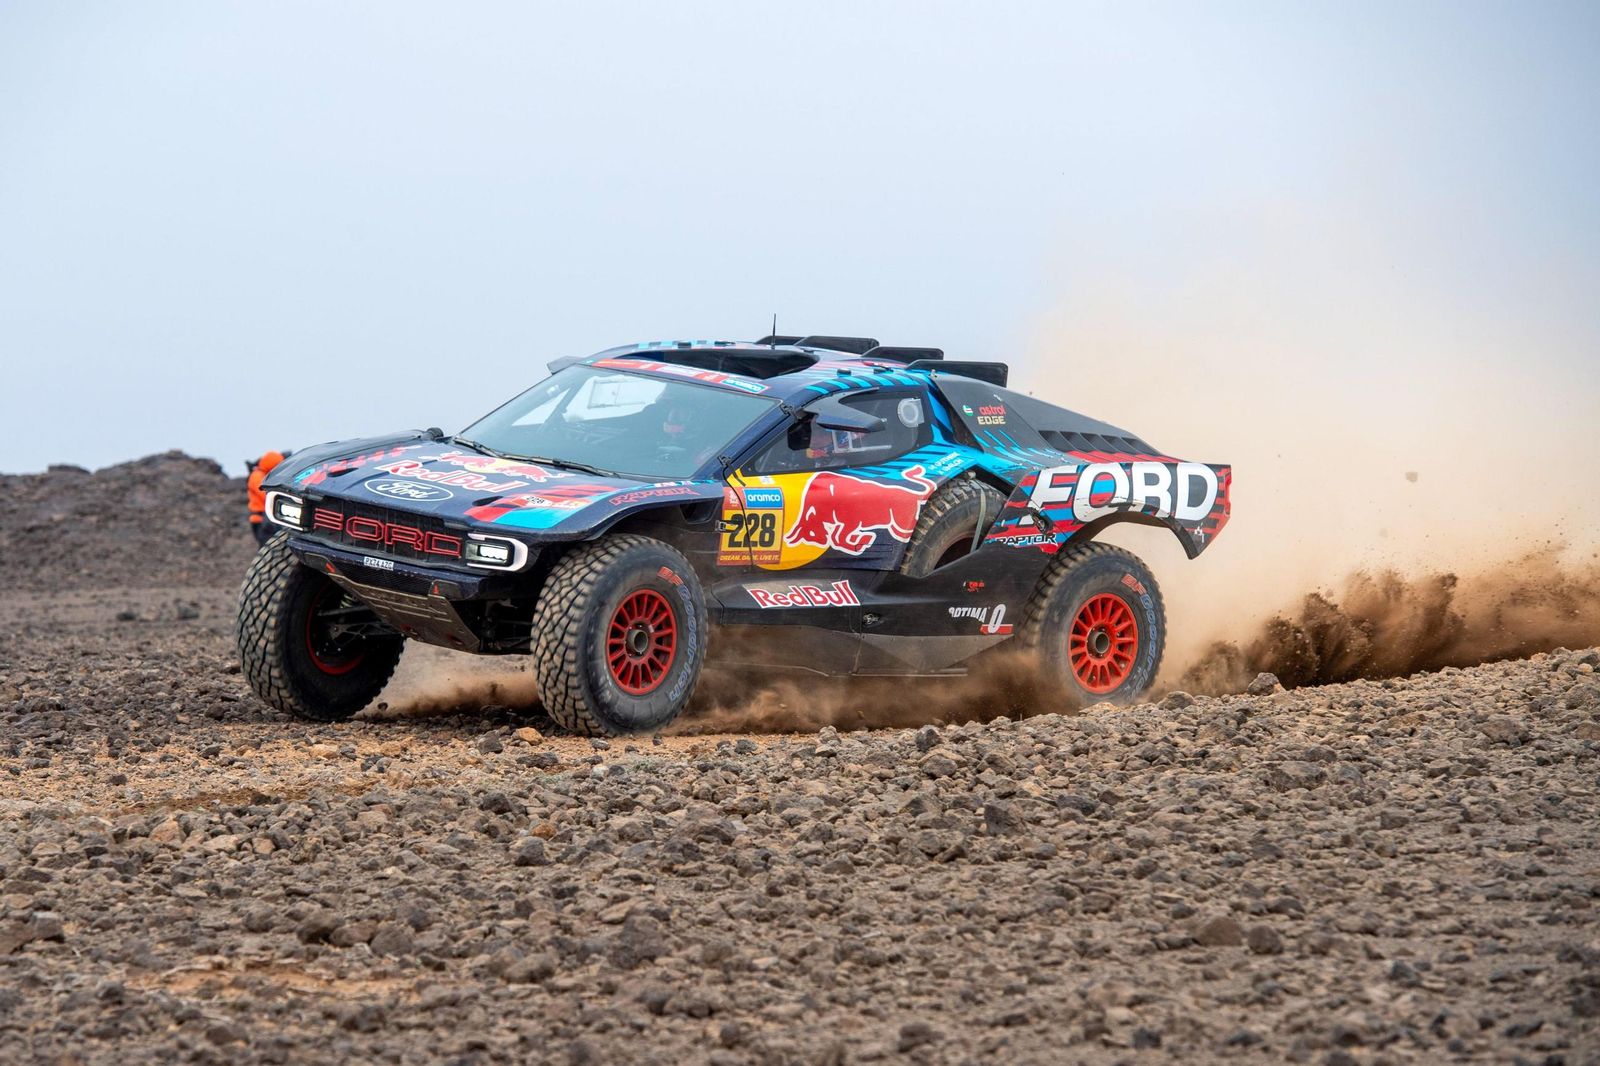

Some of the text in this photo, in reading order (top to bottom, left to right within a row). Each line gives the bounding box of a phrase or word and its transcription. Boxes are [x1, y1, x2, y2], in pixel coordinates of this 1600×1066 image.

[977, 416, 1006, 425] EDGE
[376, 481, 439, 499] Ford
[747, 494, 781, 502] aramco
[1018, 462, 1218, 523] FORD
[313, 507, 463, 559] FORD
[728, 513, 776, 548] 228
[747, 580, 861, 608] Red Bull
